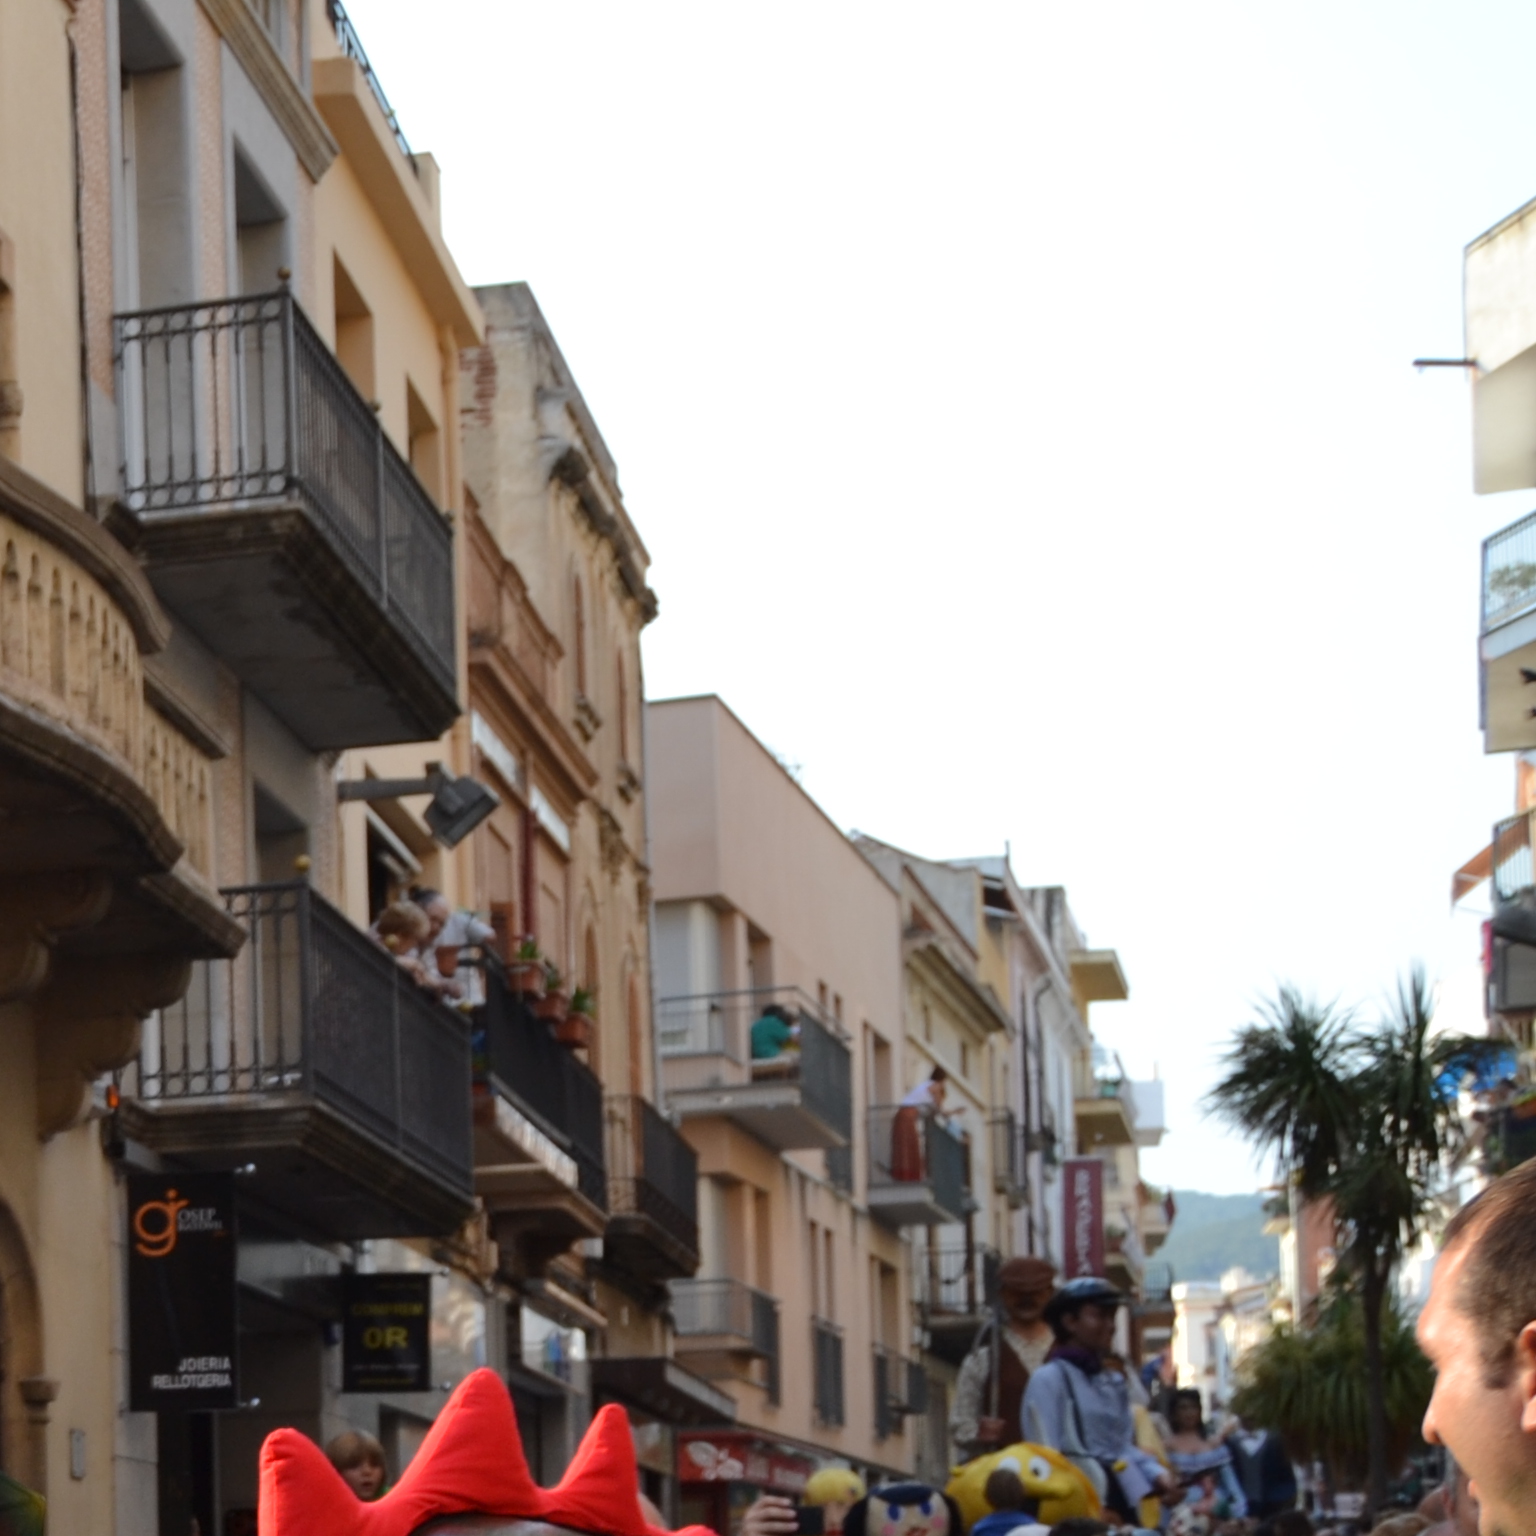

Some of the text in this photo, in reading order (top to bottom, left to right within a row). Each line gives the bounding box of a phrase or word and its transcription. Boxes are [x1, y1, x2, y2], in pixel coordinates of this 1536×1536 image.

[362, 1325, 409, 1350] OR
[178, 1355, 231, 1372] JOIERIA
[152, 1373, 232, 1389] RELLOTGERIA
